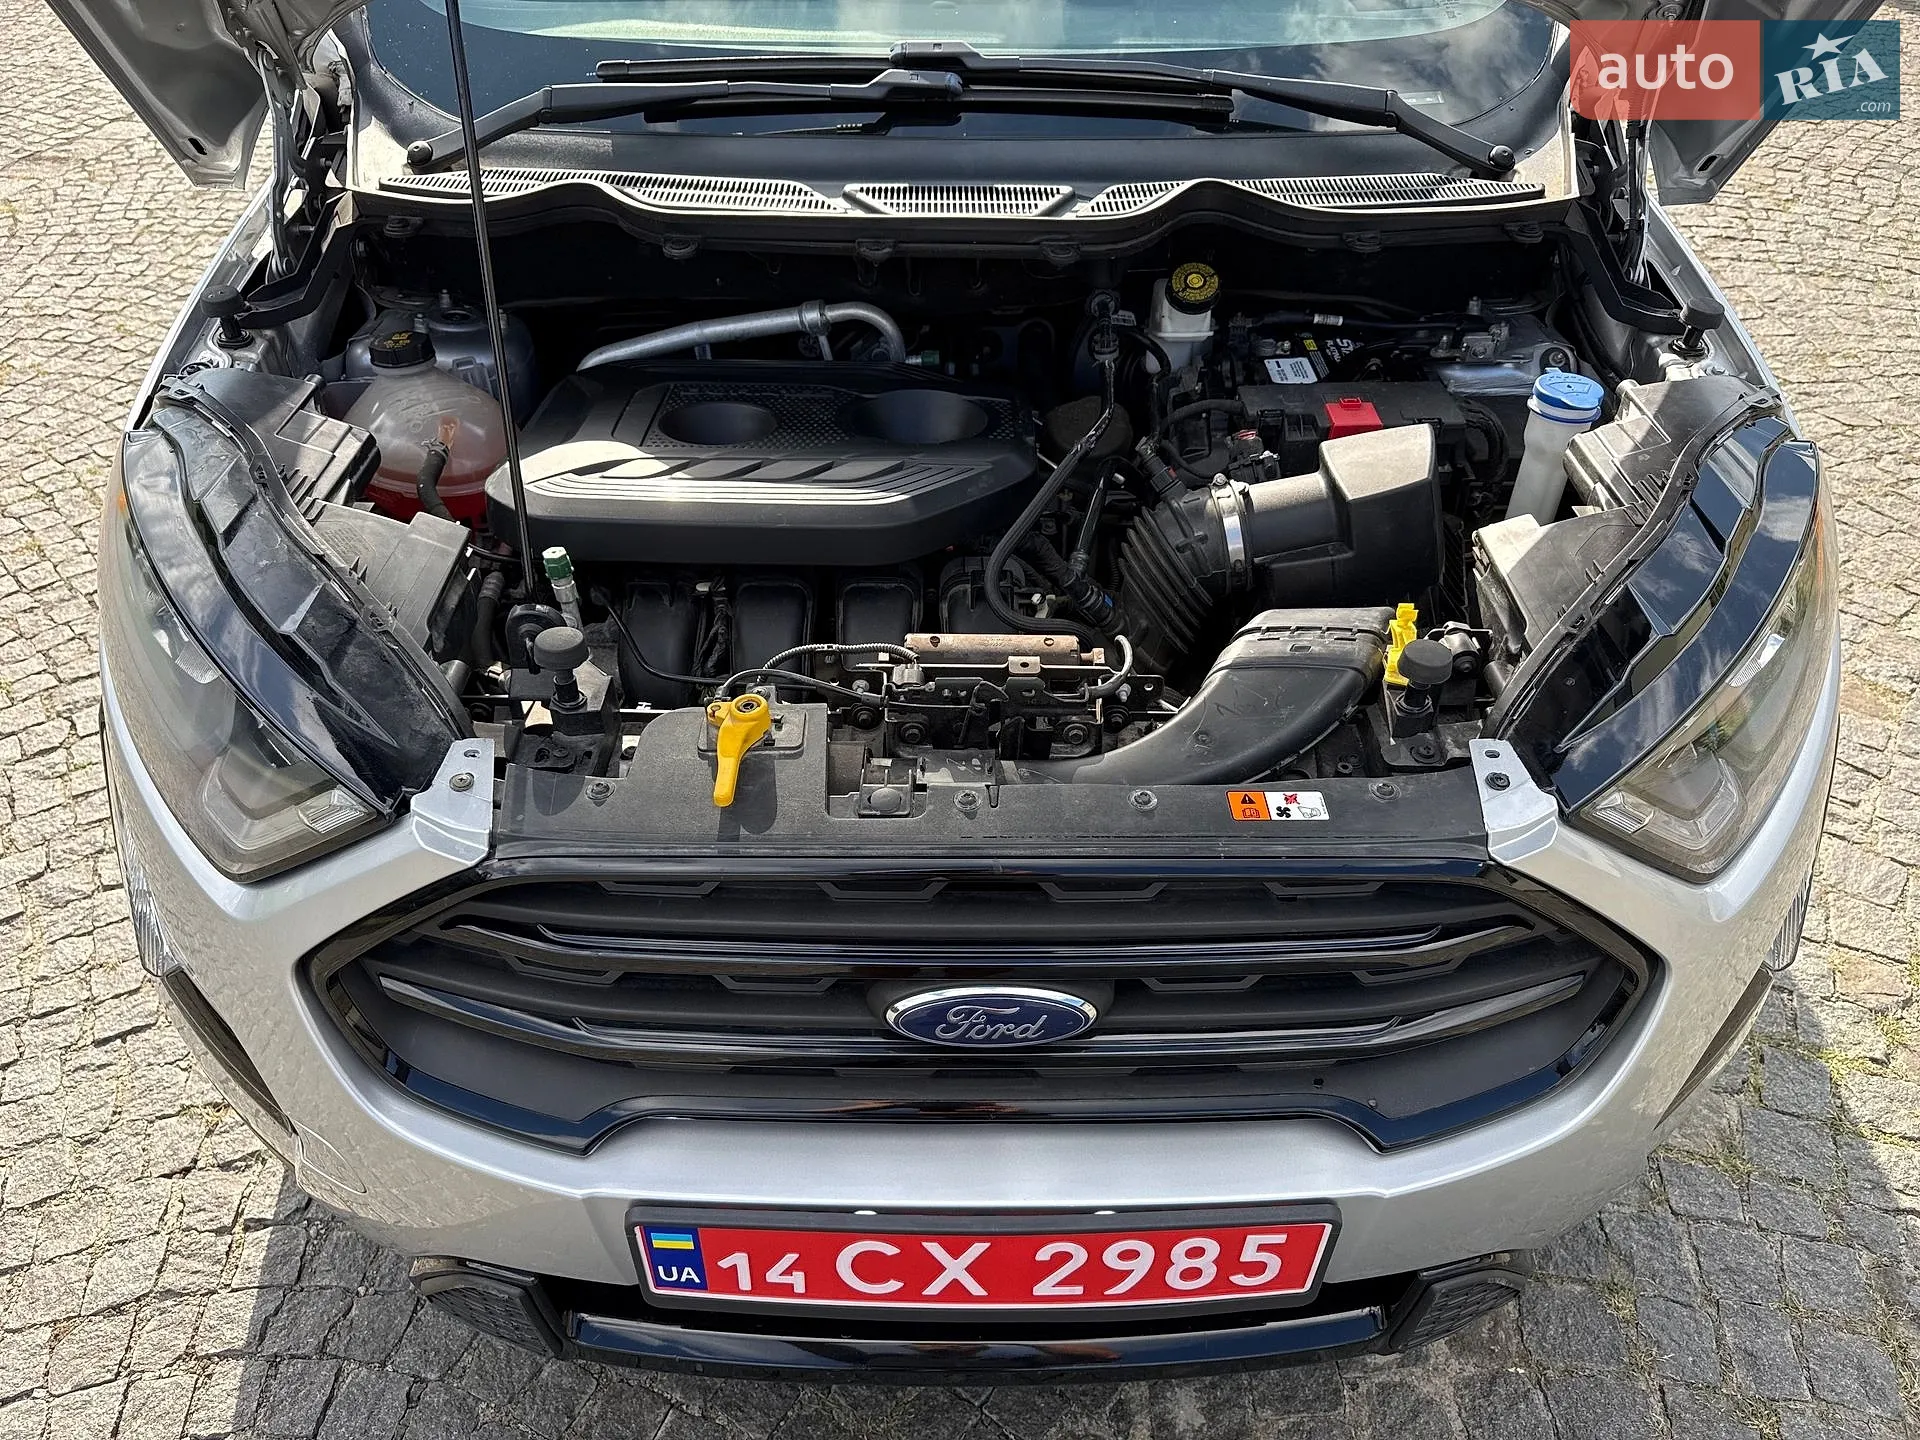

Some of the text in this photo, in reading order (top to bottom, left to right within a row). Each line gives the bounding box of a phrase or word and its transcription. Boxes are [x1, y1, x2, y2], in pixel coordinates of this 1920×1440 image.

[935, 1005, 1048, 1039] Ford
[657, 1265, 701, 1283] UA
[717, 1234, 1288, 1296] 14 CX 2985
